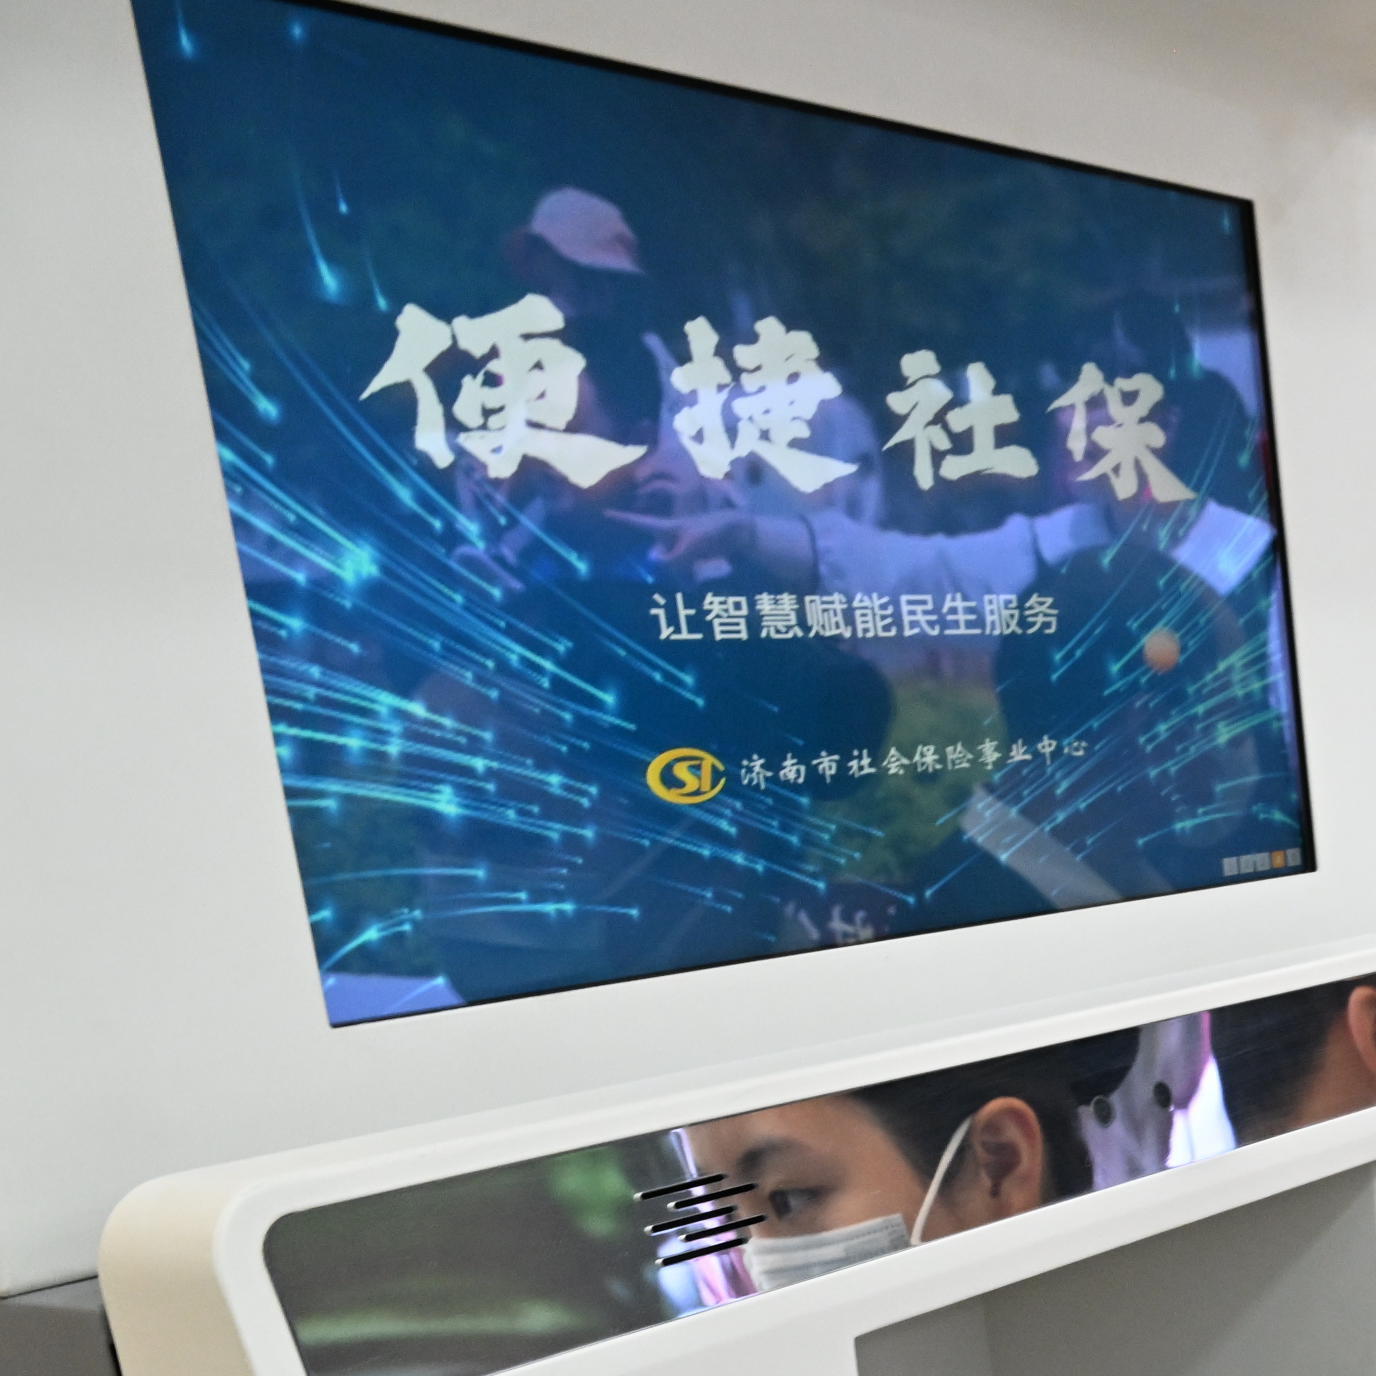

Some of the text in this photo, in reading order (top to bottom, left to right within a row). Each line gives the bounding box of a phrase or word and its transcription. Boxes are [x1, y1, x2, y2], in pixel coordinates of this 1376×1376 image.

[360, 293, 1196, 503] 便捷社保
[650, 592, 1059, 641] 让智慧赋能民生服务
[740, 735, 1088, 790] 济南市社会保险事业中心
